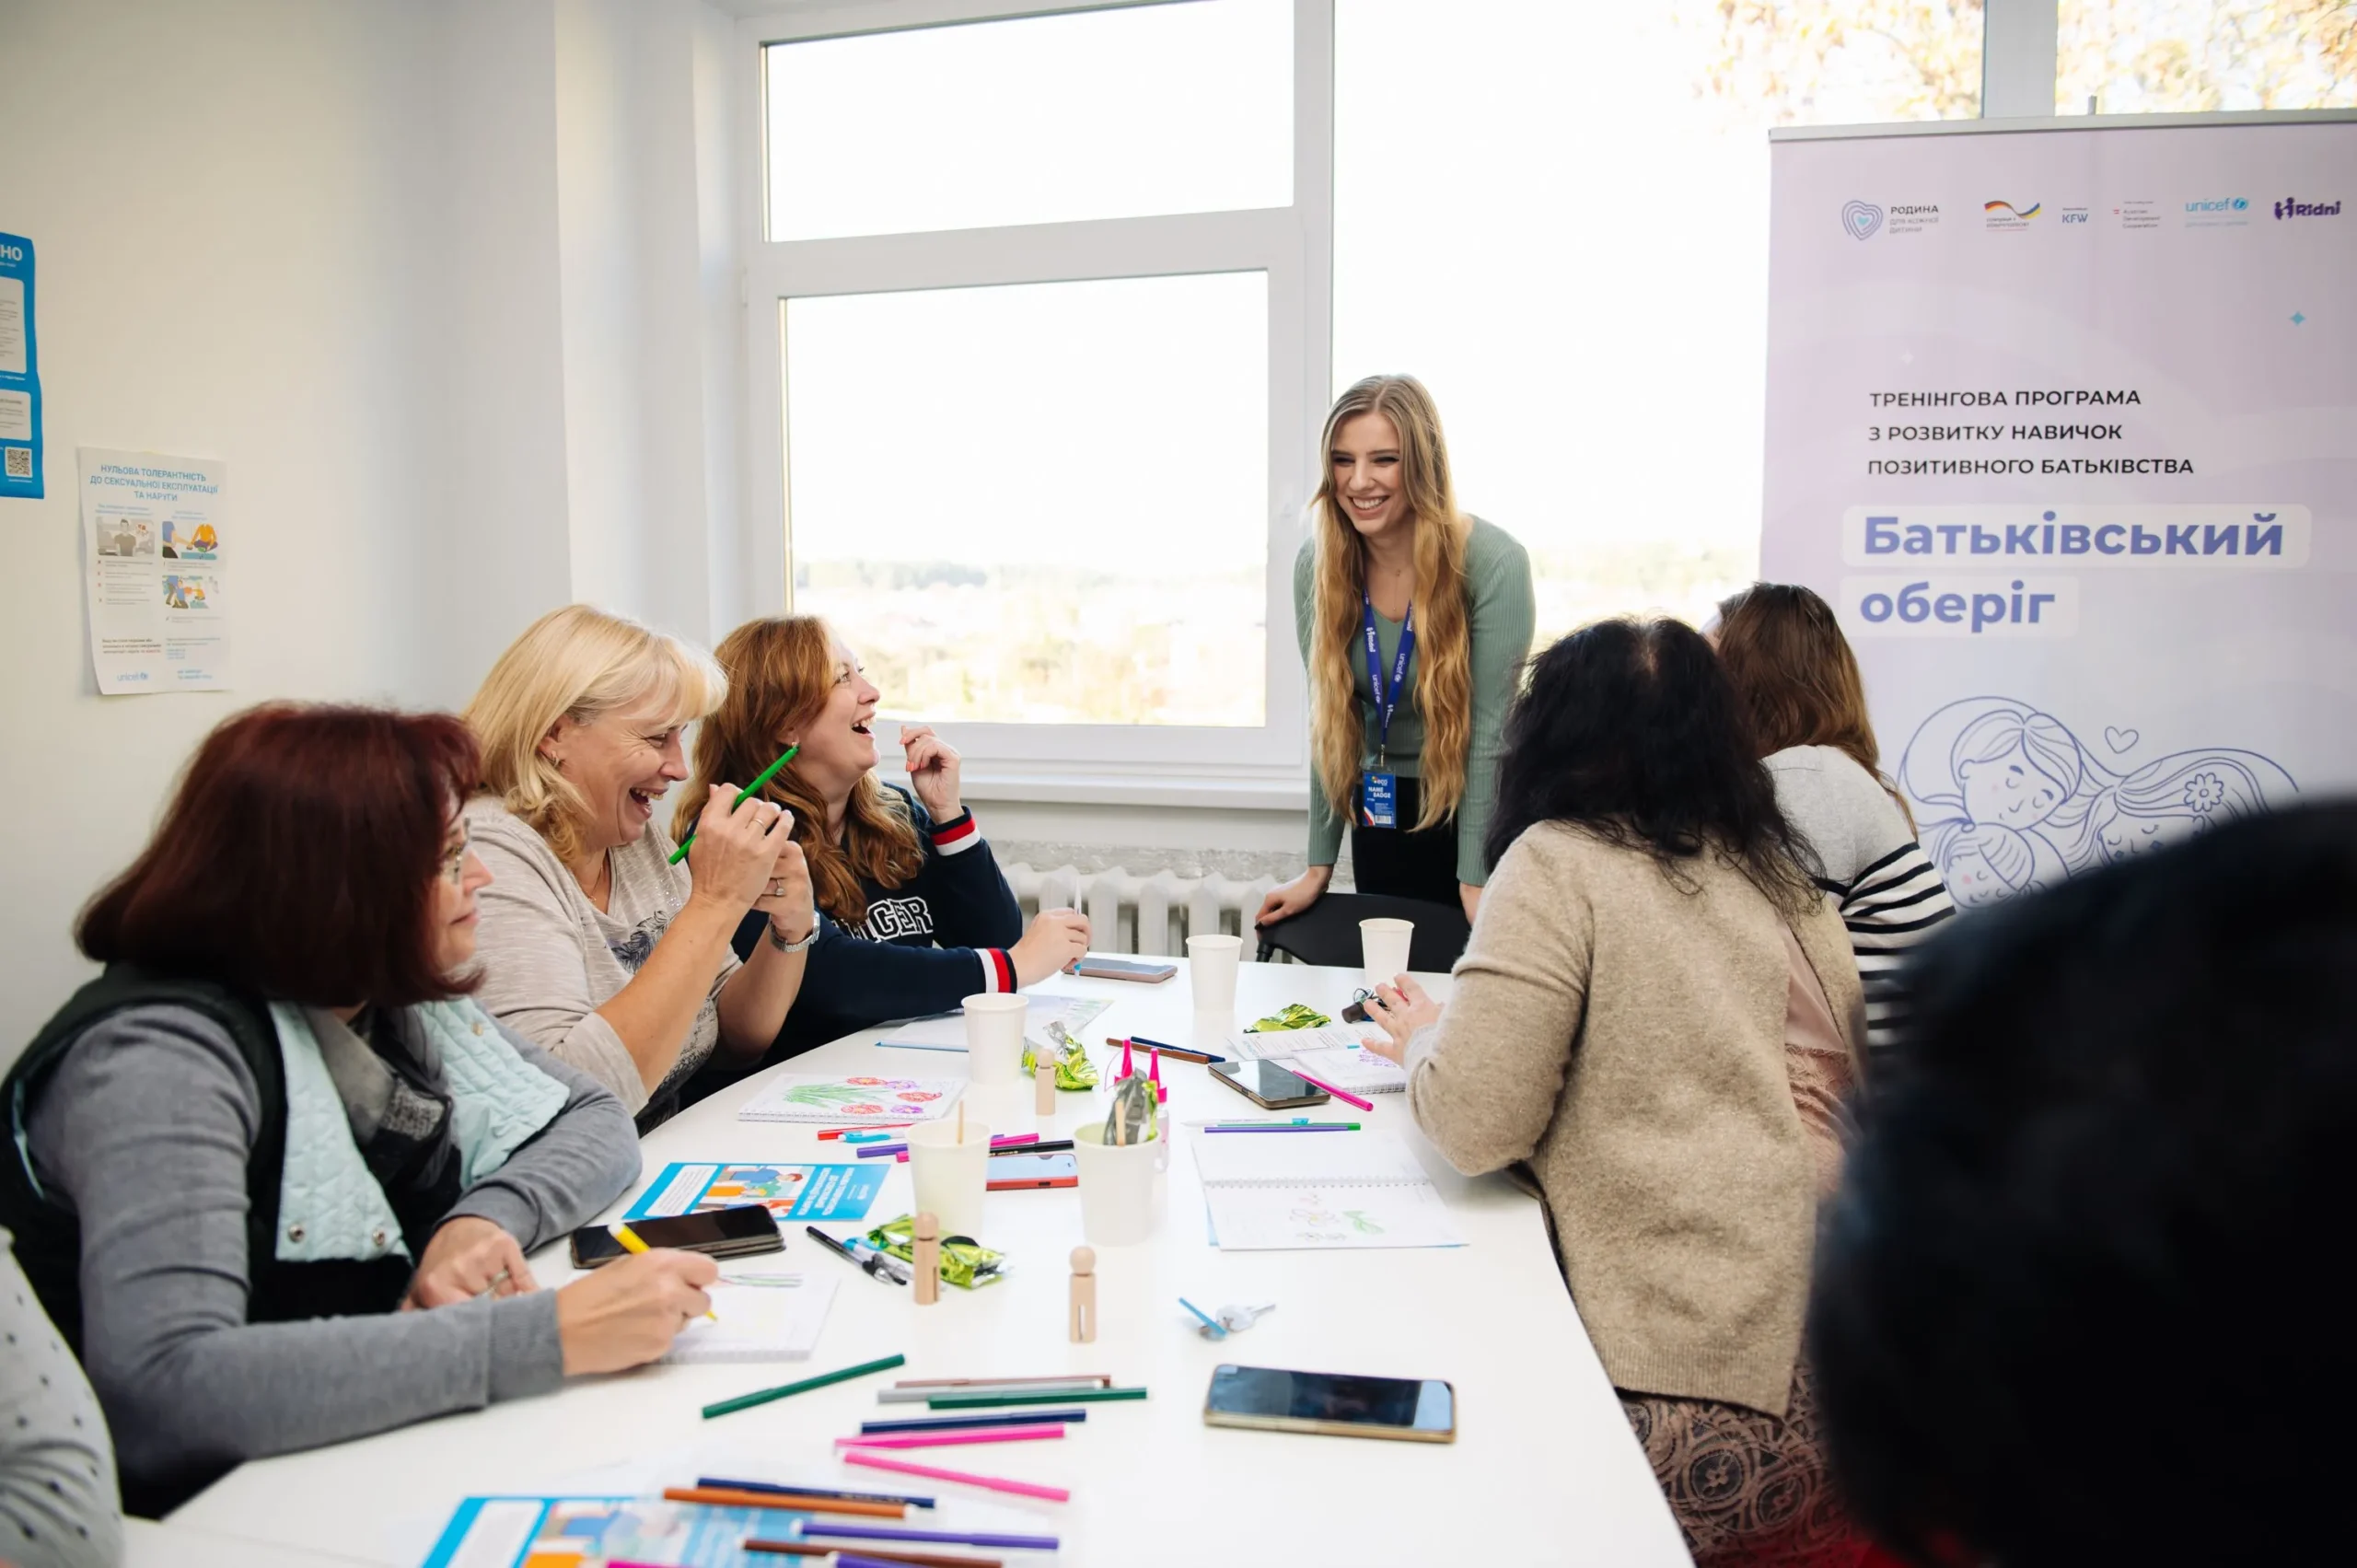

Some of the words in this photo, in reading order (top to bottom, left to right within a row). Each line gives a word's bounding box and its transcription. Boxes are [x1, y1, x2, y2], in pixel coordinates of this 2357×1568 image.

[1890, 204, 1939, 215] РОДИНА
[2185, 197, 2231, 213] unicef
[1869, 390, 2008, 407] ТРЕНІНГОВА
[2014, 389, 2142, 406] ПРОГРАМА
[1868, 426, 1881, 441] З
[1887, 425, 2004, 440] РОЗВИТКУ
[2012, 424, 2122, 440] НАВИЧОК
[100, 464, 139, 476] НУЛЬОВА
[140, 468, 206, 482] ТОЛЕРАНТНІСТЬ
[1868, 459, 2034, 475] ПОЗИТИВНОГО
[2040, 459, 2194, 474] БАТЬКІВСТВА
[89, 475, 102, 484] ДО
[134, 491, 145, 499] ТА
[146, 492, 178, 502] НАРУГИ
[1864, 510, 2284, 556] Батьківський
[1859, 579, 2056, 633] оберіг
[1397, 653, 1406, 675] unicef
[862, 896, 934, 942] GER
